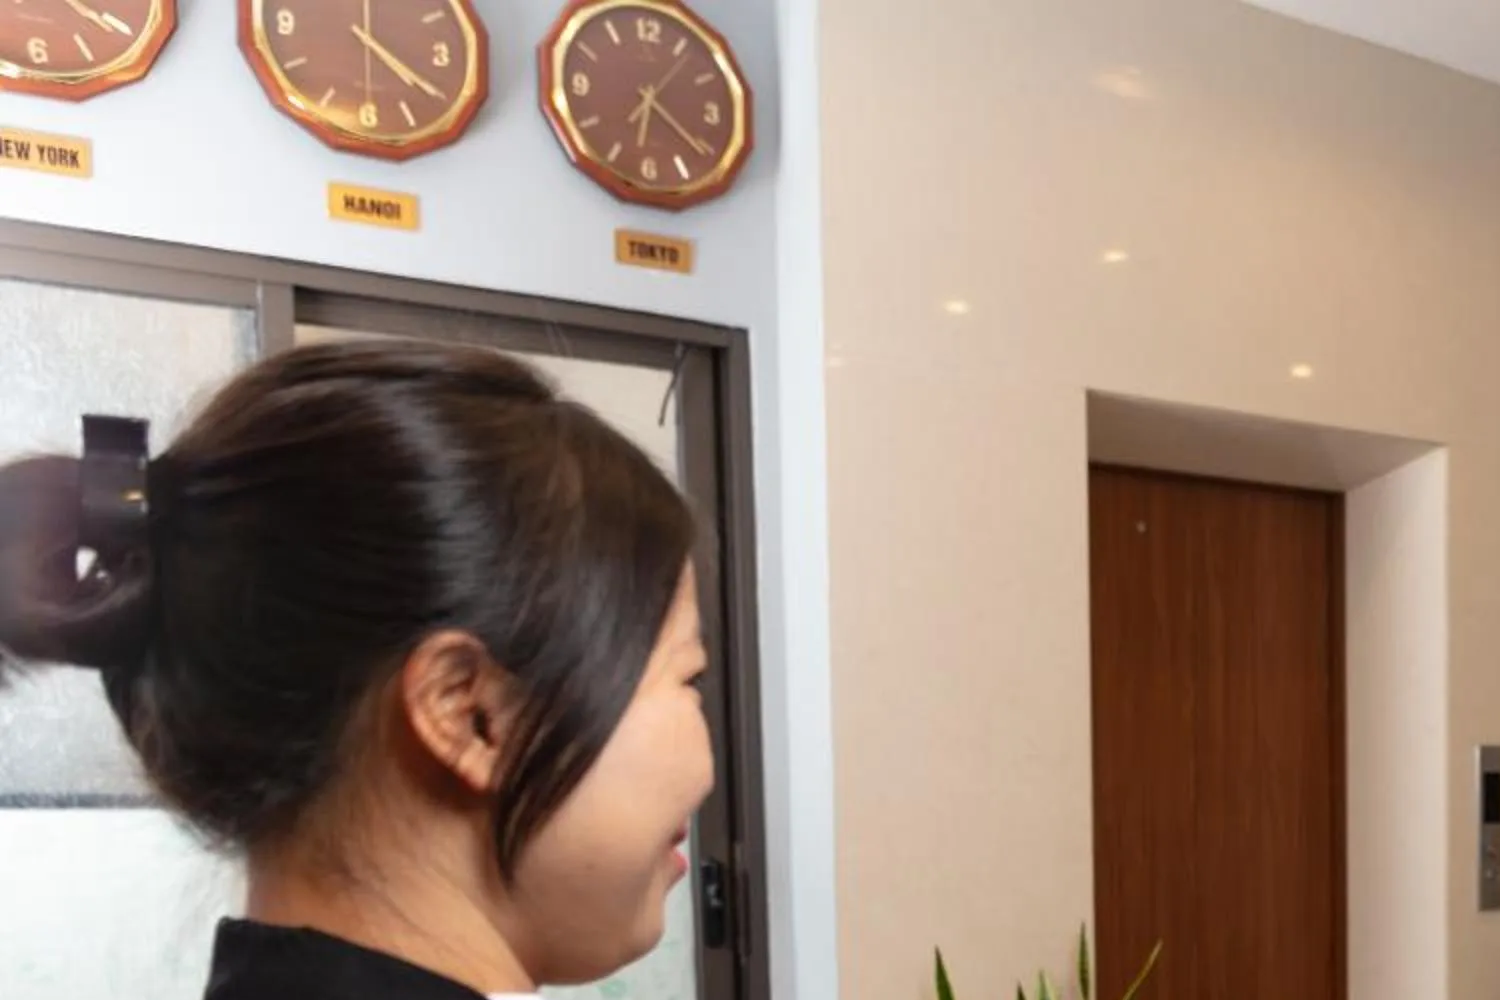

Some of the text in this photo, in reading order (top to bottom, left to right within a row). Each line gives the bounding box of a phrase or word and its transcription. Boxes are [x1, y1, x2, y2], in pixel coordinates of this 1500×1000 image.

[636, 18, 661, 43] 12
[27, 37, 49, 64] 6
[432, 42, 450, 67] 3
[572, 73, 591, 96] 9
[358, 103, 378, 128] 6
[704, 102, 720, 125] 3
[36, 144, 80, 169] YORK
[640, 157, 657, 180] 6
[343, 195, 402, 220] HANOI
[627, 240, 680, 264] TOKYO
